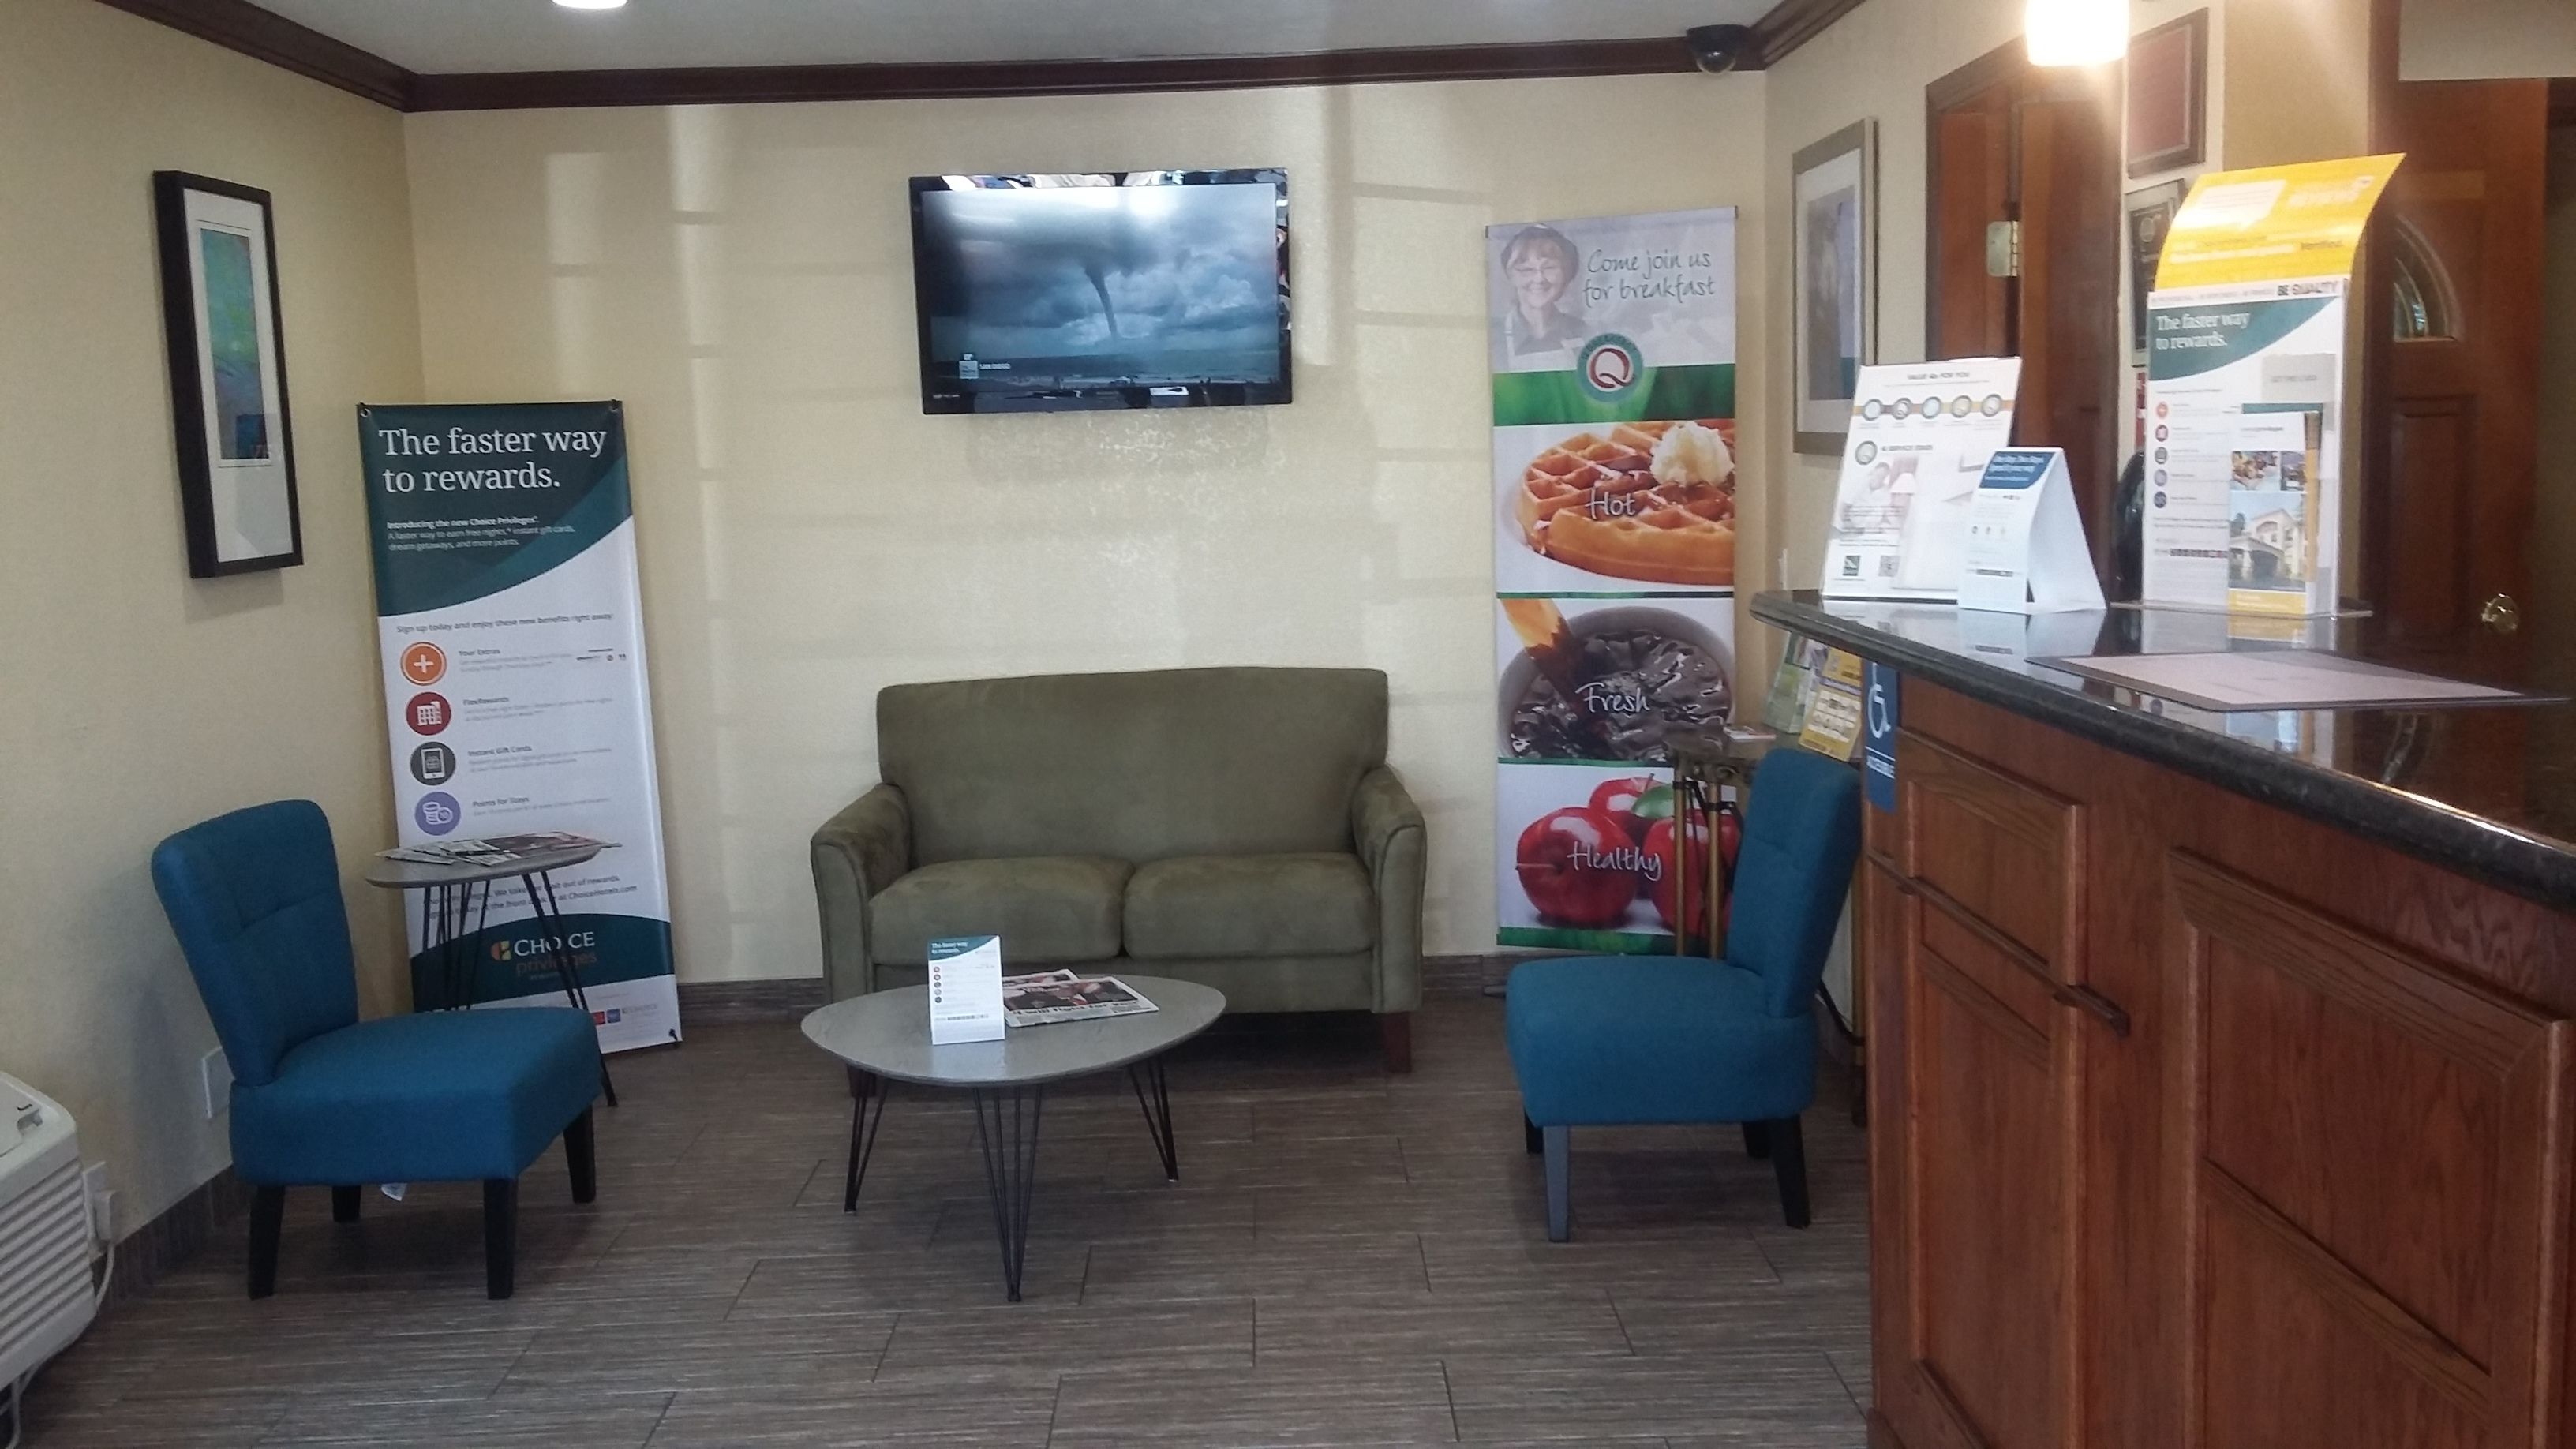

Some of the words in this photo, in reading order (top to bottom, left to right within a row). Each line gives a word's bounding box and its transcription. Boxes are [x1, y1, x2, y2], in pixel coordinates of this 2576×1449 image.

[1587, 249, 1638, 274] Come
[1644, 250, 1682, 279] join
[1688, 251, 1712, 268] us
[1582, 279, 1613, 308] for
[1619, 274, 1715, 304] breakfast
[2155, 315, 2181, 331] The
[2182, 313, 2219, 328] faster
[2155, 338, 2169, 350] to
[2170, 331, 2227, 349] rewards.
[1589, 347, 1635, 388] Q
[378, 427, 440, 456] The
[447, 427, 536, 455] faster
[543, 430, 607, 459] way
[383, 469, 415, 492] to
[423, 462, 561, 492] rewards.
[1584, 487, 1636, 519] Hot
[1575, 683, 1650, 714] Fresh
[1568, 841, 1662, 882] Healthy
[514, 931, 595, 957] CHOCE
